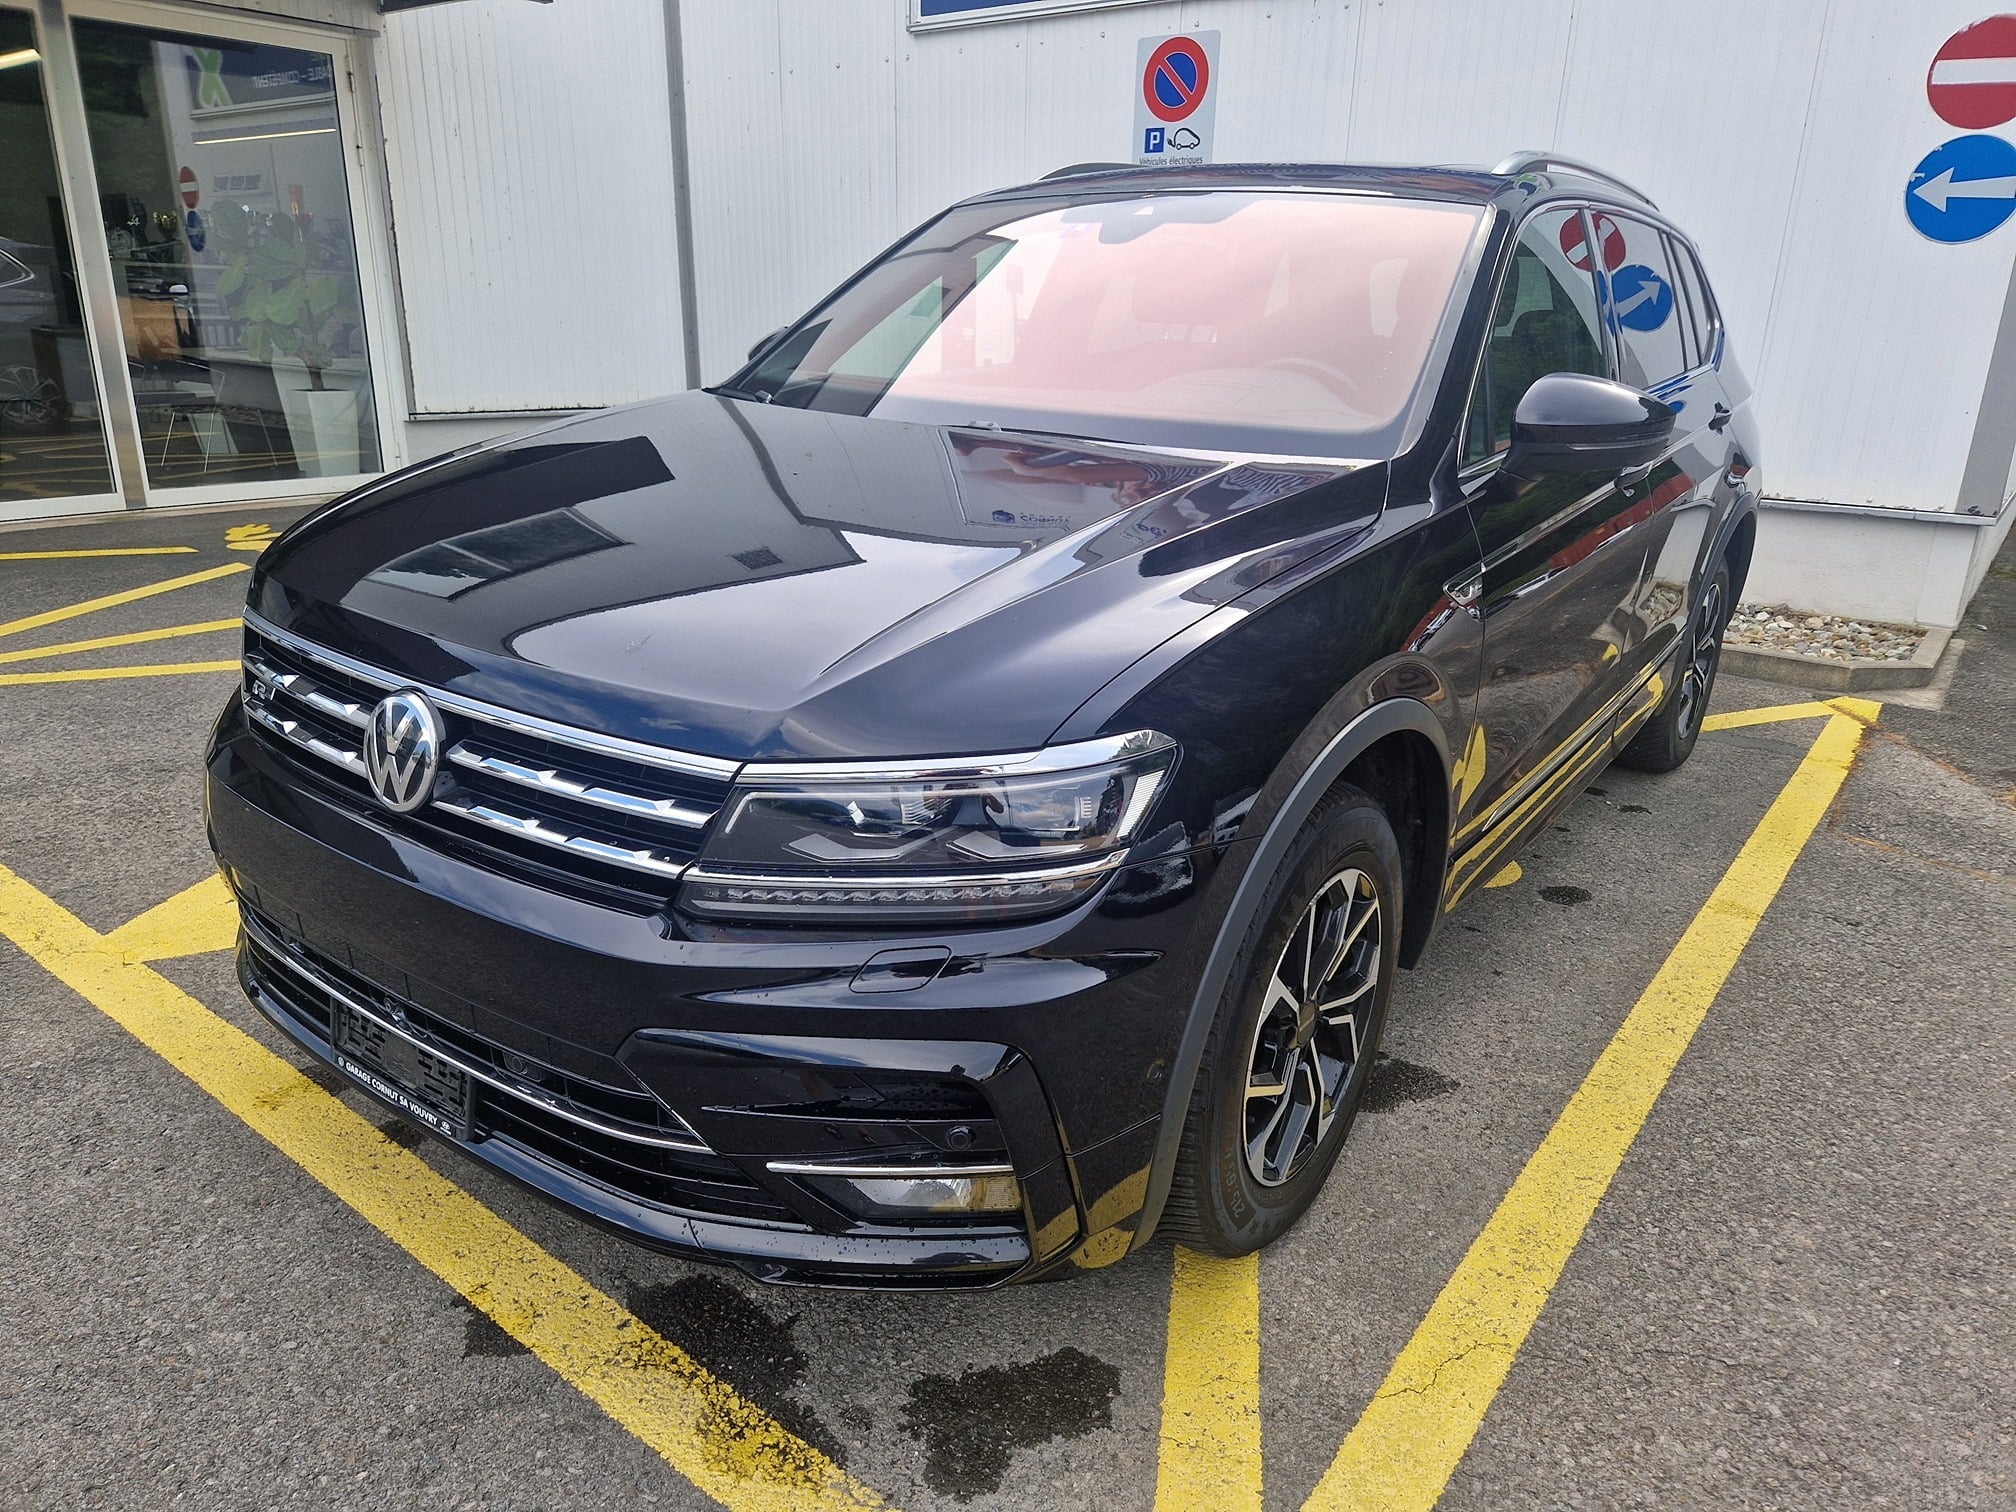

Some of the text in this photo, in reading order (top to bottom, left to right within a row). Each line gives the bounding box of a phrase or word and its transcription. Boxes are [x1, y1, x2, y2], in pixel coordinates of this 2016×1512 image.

[1149, 131, 1161, 151] P
[1139, 154, 1203, 166] Véhicules électriques
[345, 1062, 438, 1126] GARAGE CORNUT SA VOUVRY
